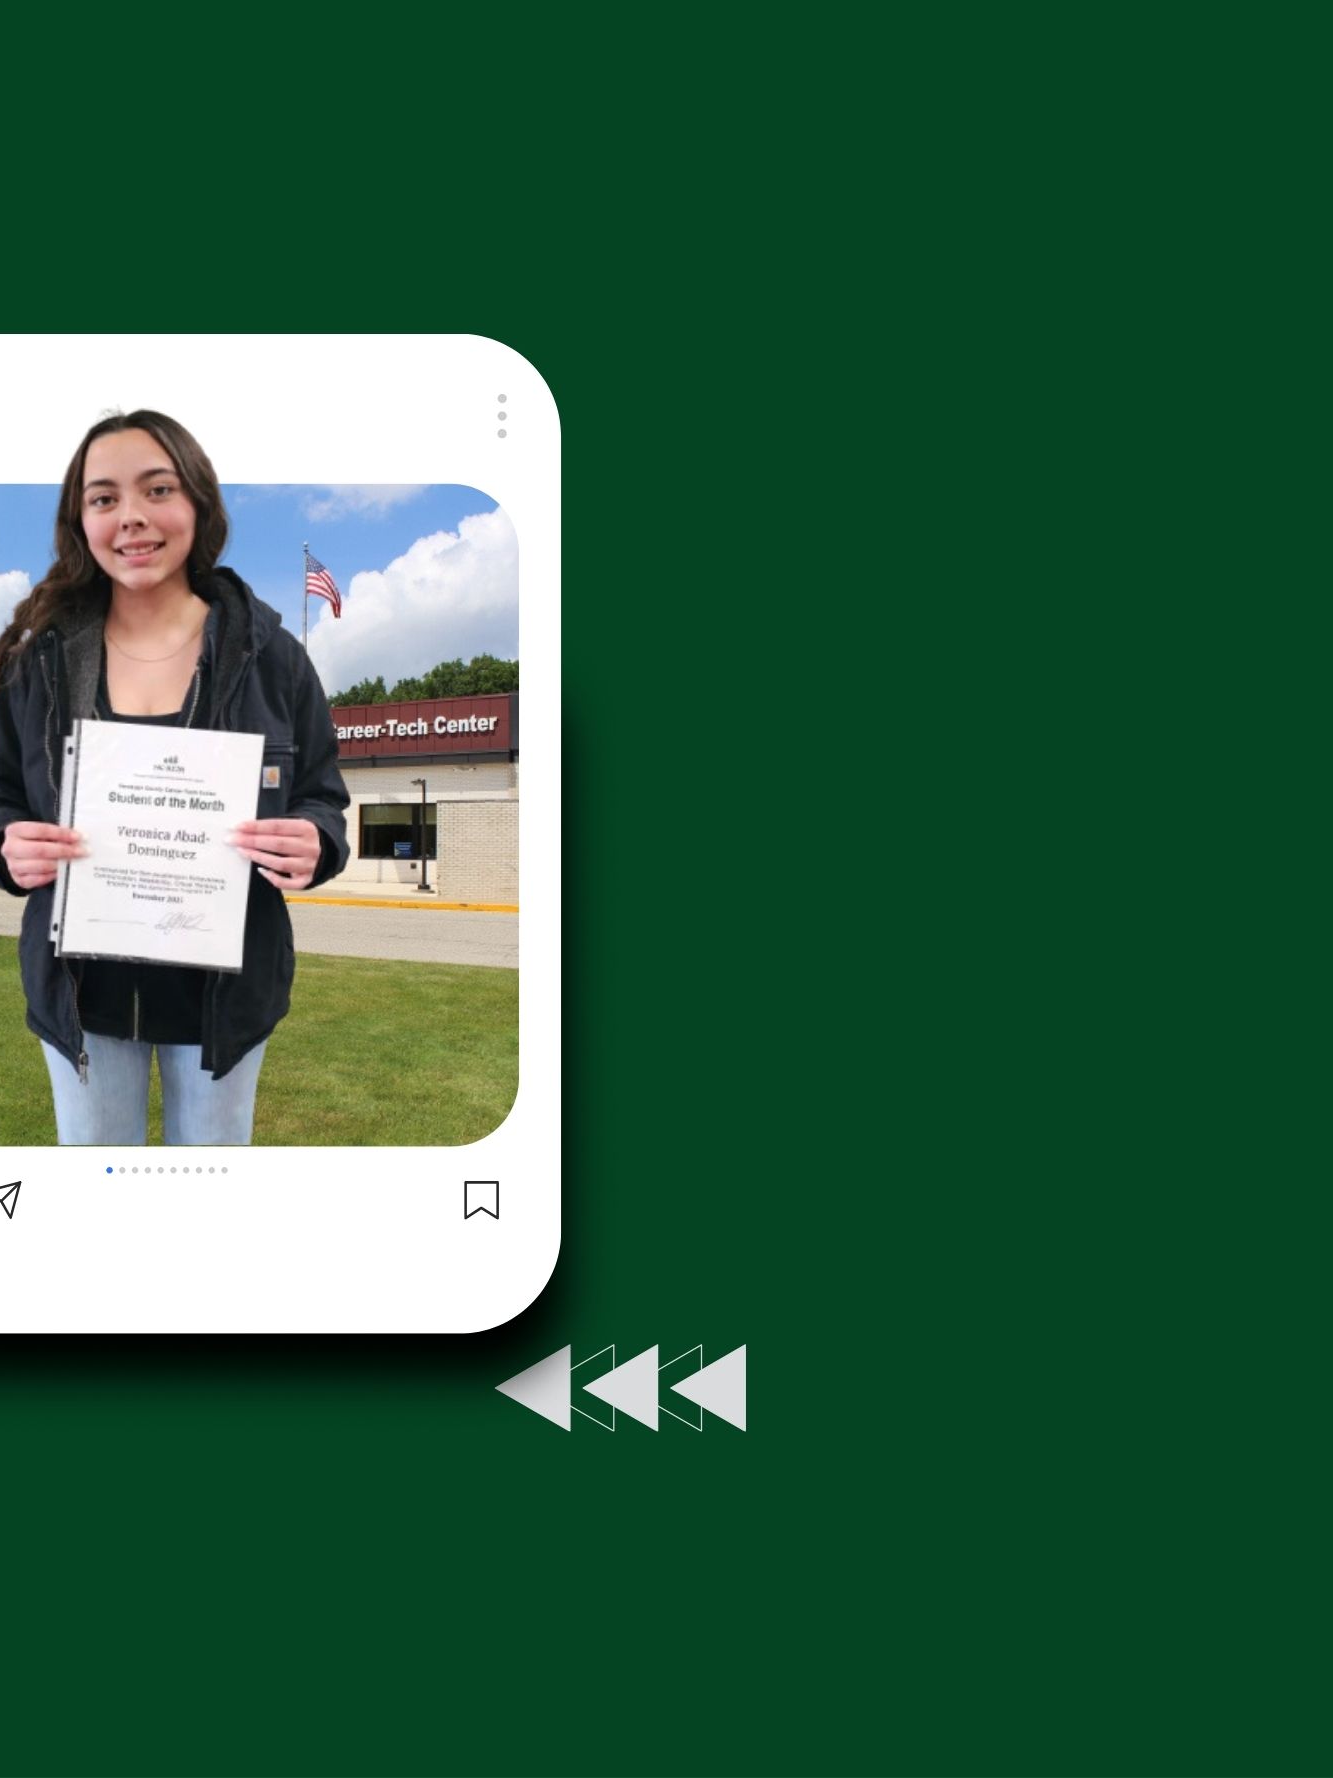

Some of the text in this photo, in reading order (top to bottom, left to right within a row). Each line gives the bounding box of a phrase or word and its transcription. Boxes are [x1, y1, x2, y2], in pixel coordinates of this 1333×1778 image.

[333, 713, 497, 740] areer-Tech Center
[108, 791, 225, 812] Student of the Month
[117, 826, 210, 844] Veronica Abad-
[127, 843, 197, 860] Dominguez
